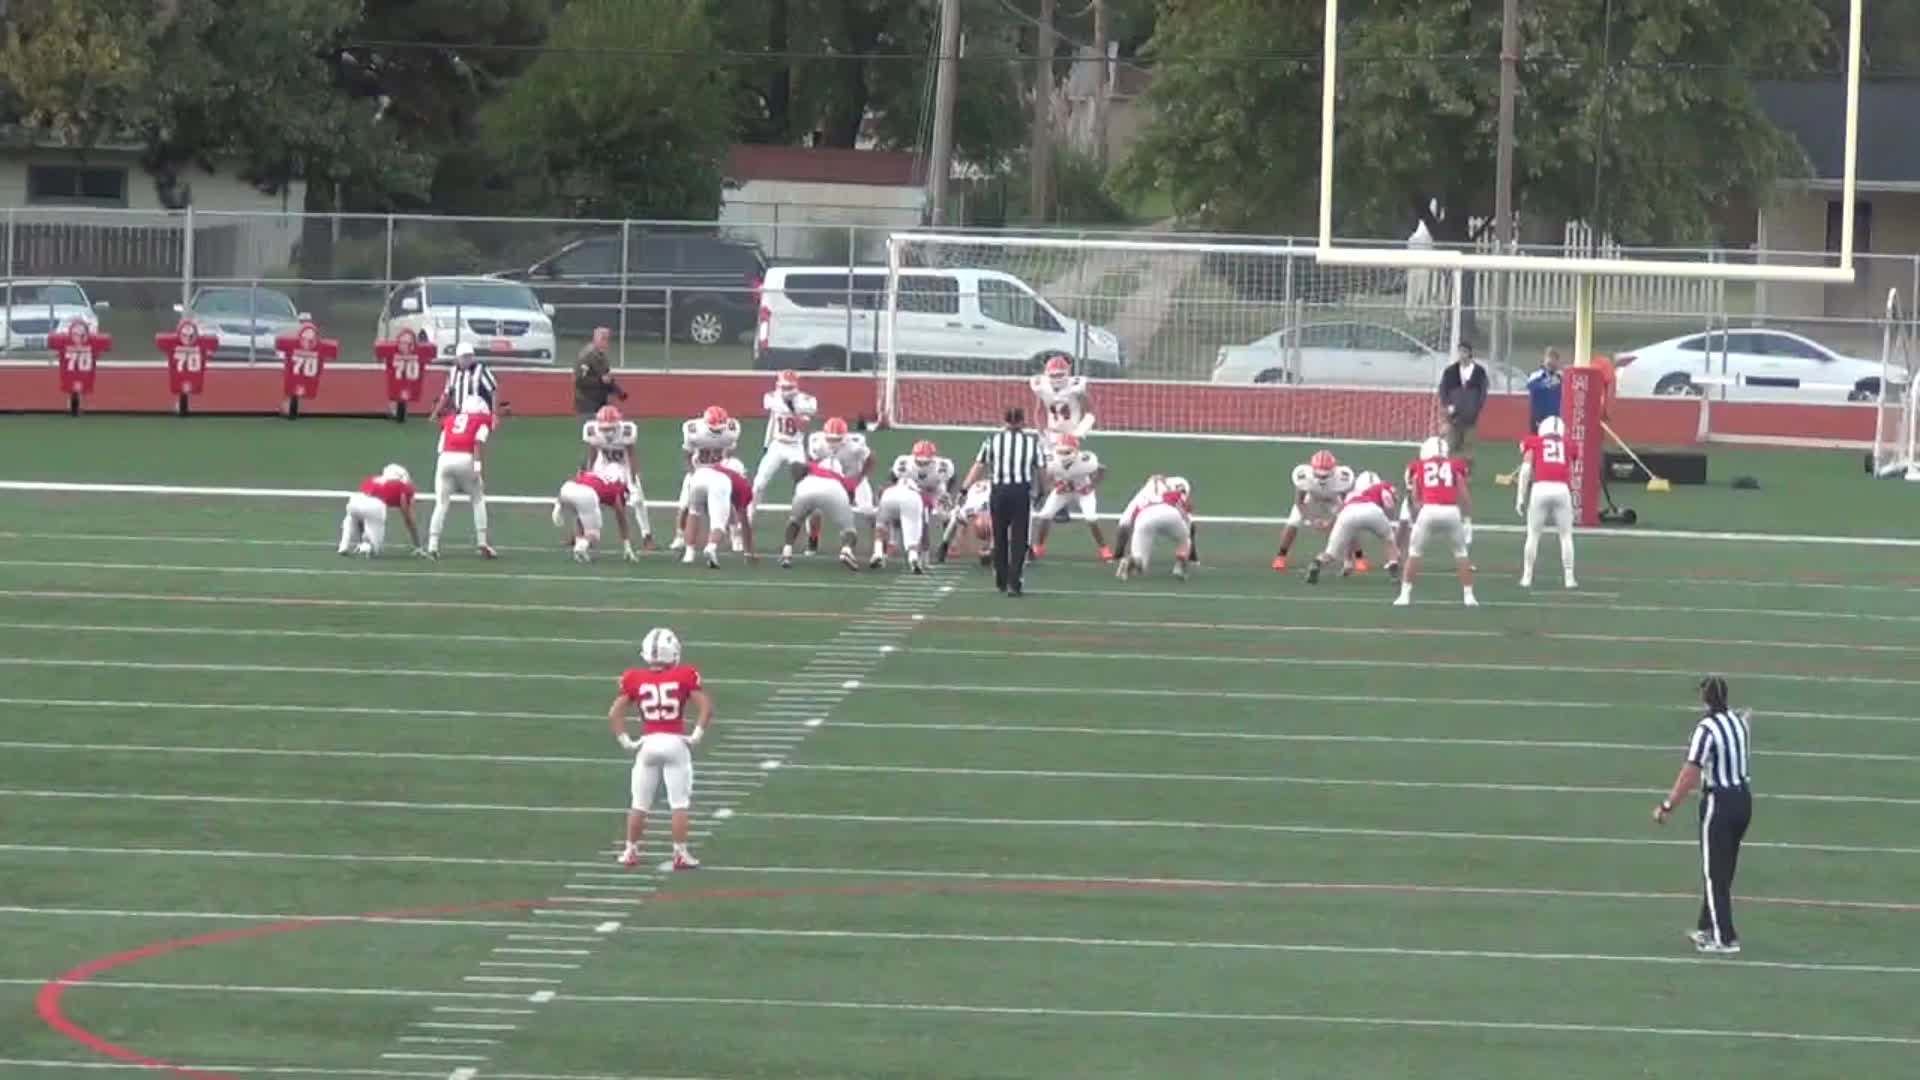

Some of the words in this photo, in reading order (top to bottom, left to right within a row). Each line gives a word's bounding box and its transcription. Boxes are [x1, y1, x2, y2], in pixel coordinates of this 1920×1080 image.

[65, 351, 93, 371] 70
[173, 351, 202, 372] 70
[291, 356, 319, 377] 70
[392, 359, 420, 380] 70
[451, 413, 470, 434] 9
[1543, 440, 1566, 463] 21
[1423, 461, 1453, 486] 24
[639, 682, 680, 720] 25
